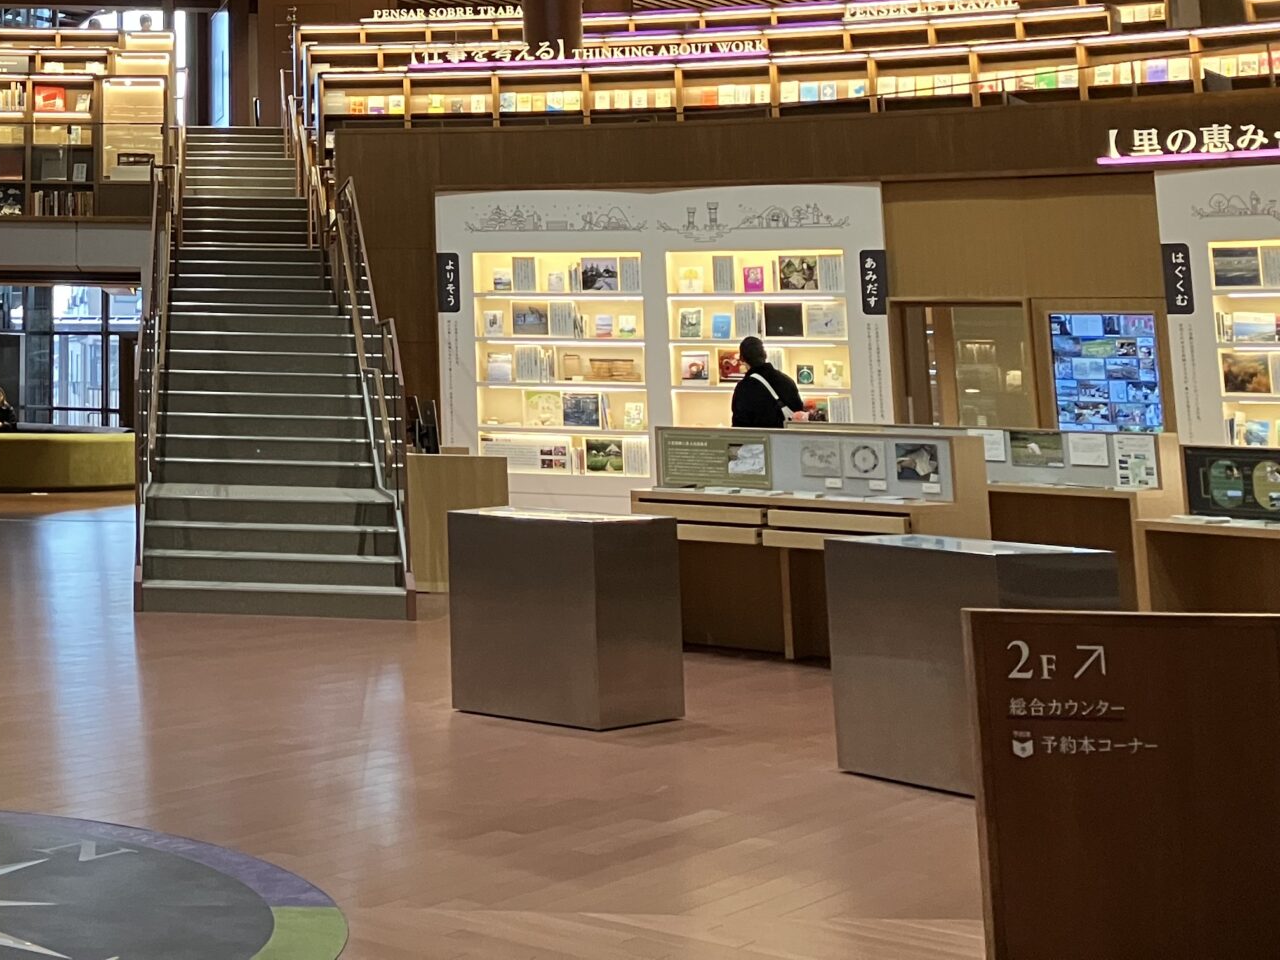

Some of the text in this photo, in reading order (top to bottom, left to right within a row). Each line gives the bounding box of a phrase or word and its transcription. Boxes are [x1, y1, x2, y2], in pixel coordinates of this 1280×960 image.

[373, 8, 427, 20] PENSAR
[428, 6, 474, 19] SOBRE
[571, 39, 767, 61] THINKING ABOUT WORK
[445, 260, 456, 306] よりそう
[864, 257, 878, 308] あみだす
[1171, 252, 1189, 306] はぐくむ
[1006, 640, 1056, 680] 2F
[1009, 697, 1125, 717] 総合カウンター
[1041, 735, 1158, 755] 予約本コーナー
